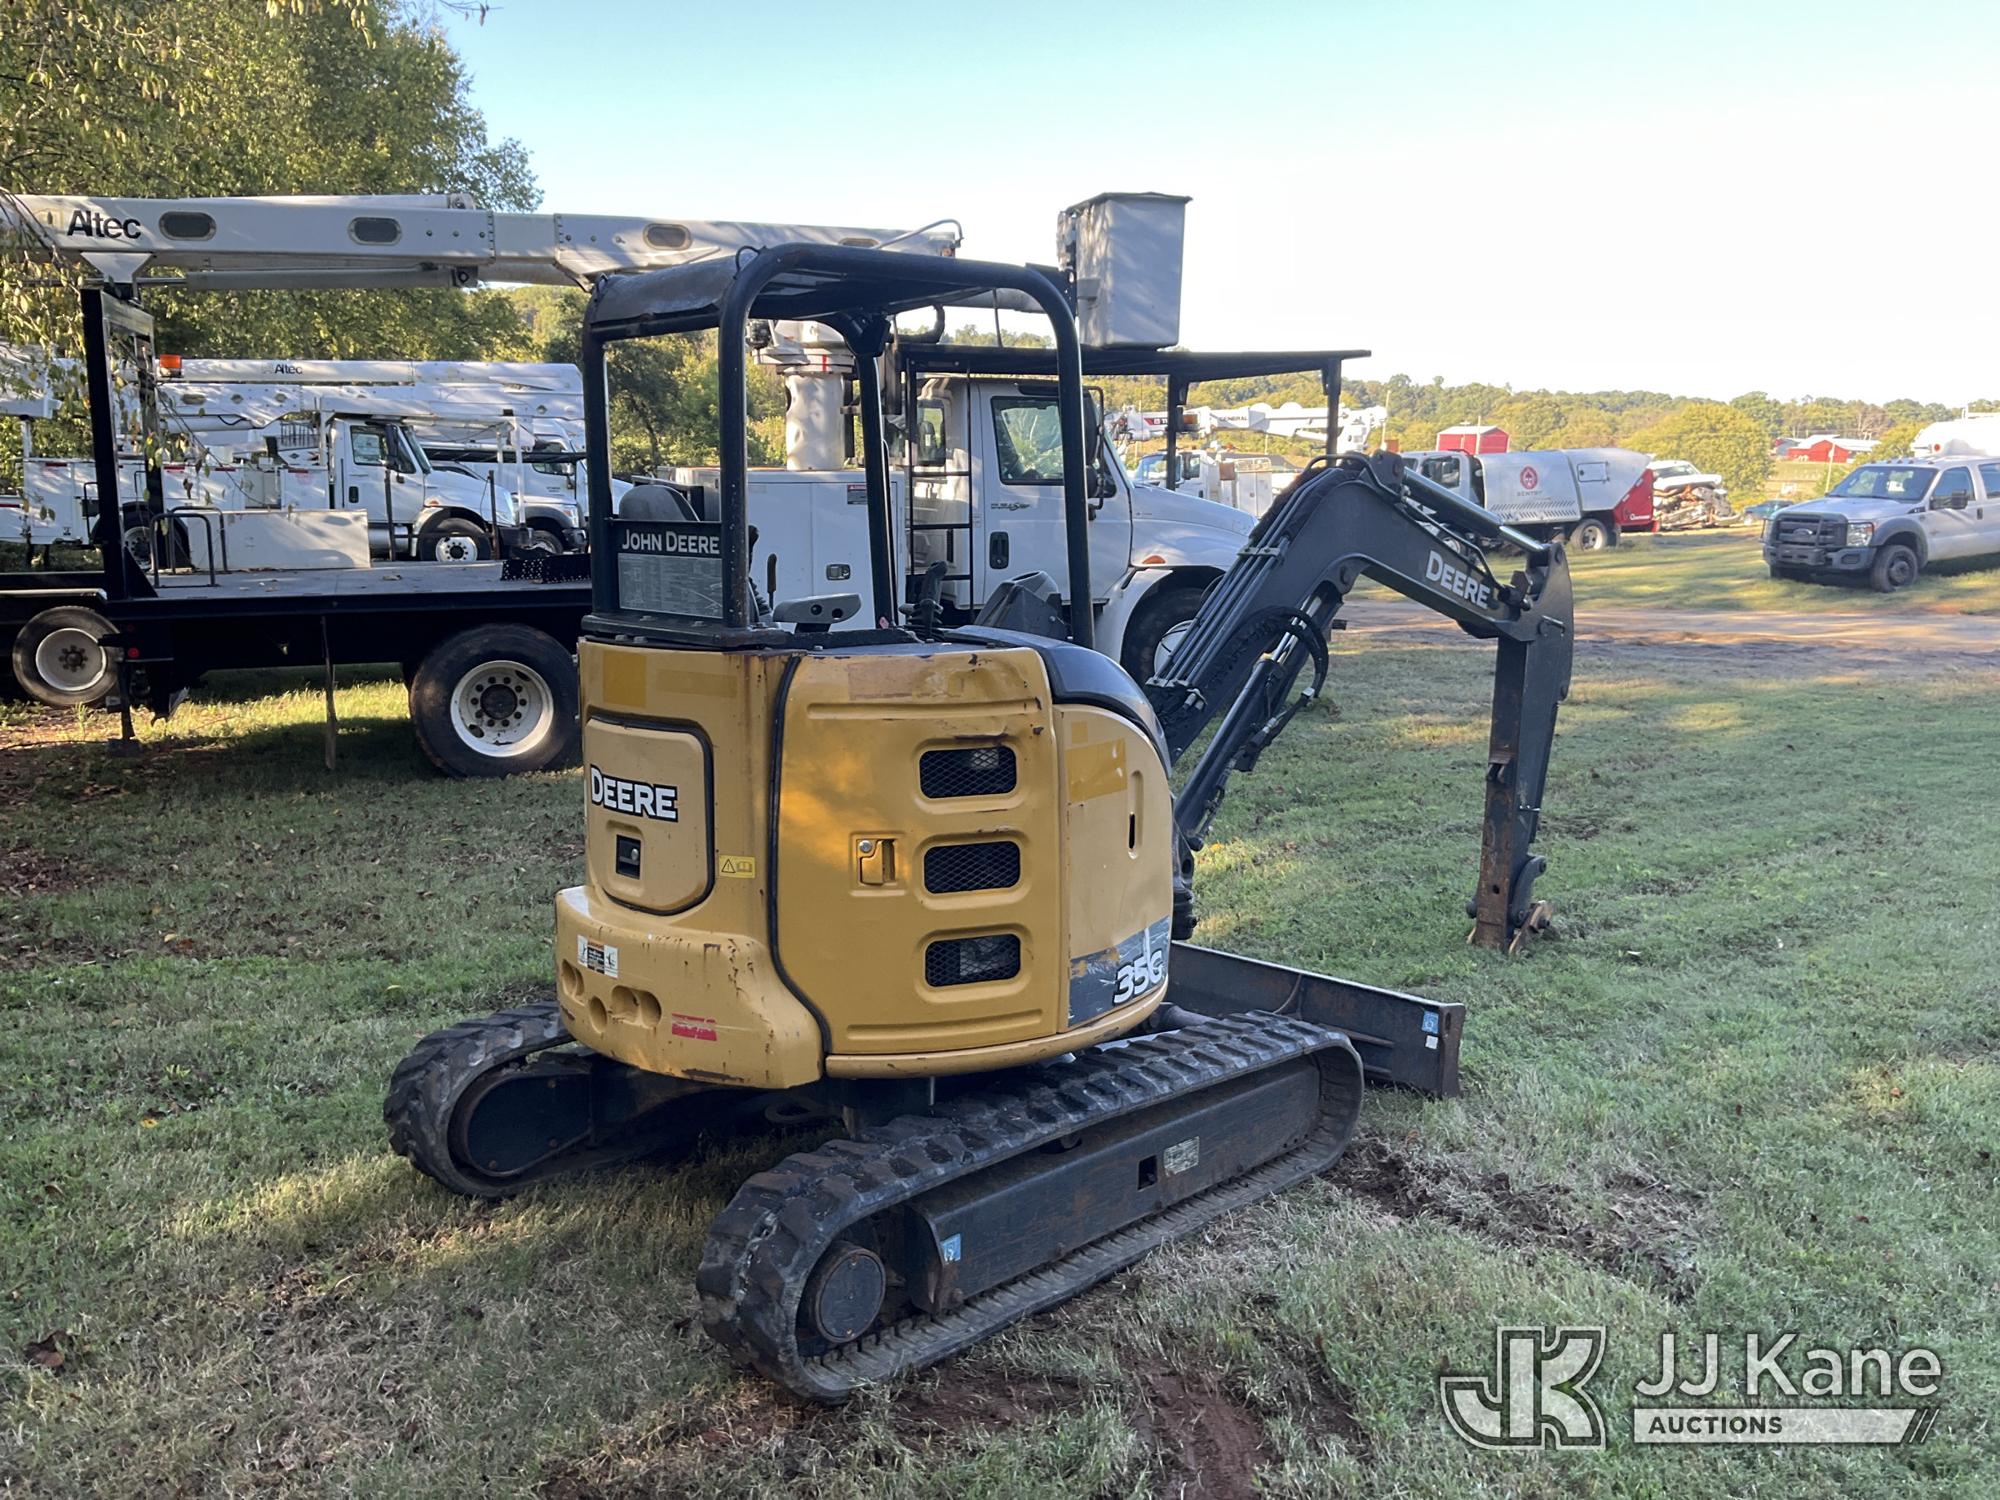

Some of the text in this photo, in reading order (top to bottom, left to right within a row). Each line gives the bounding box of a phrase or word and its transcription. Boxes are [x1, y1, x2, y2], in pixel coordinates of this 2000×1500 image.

[67, 209, 141, 239] Altec
[274, 363, 303, 375] Altec
[622, 529, 720, 555] JOHN DEERE
[1426, 549, 1491, 609] DEERE
[590, 765, 678, 821] DEERE
